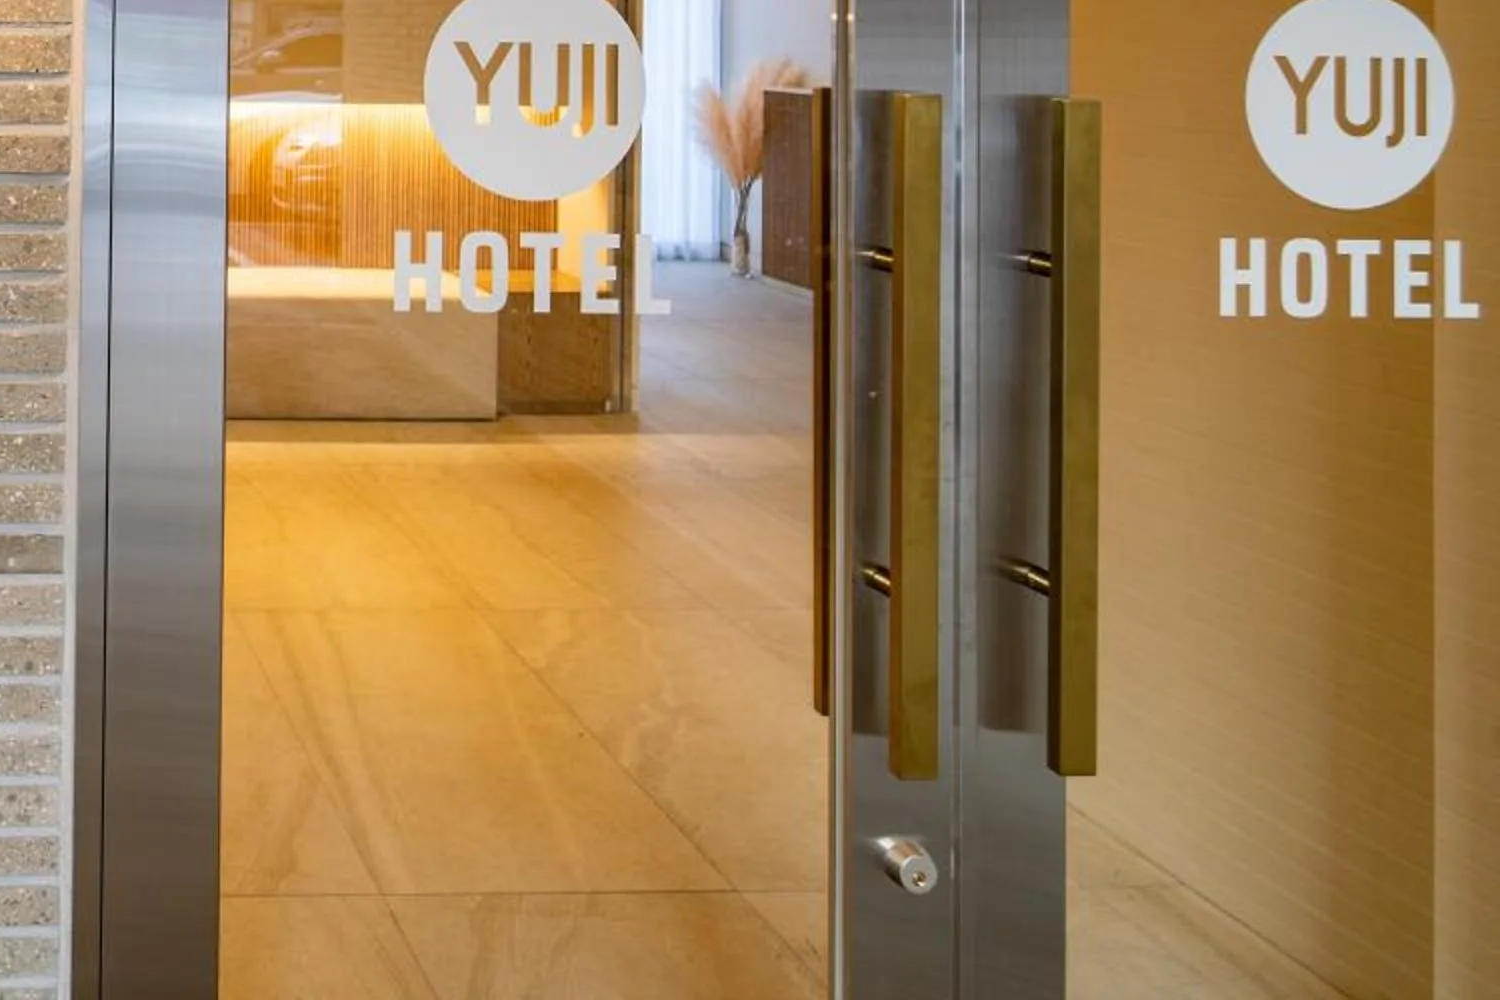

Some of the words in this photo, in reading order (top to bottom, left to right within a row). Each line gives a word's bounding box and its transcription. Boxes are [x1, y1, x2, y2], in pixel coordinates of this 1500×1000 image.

[453, 41, 619, 138] YUJI
[1273, 55, 1428, 148] YUJI
[393, 230, 672, 315] HOTEL
[1219, 237, 1480, 319] HOTEL
